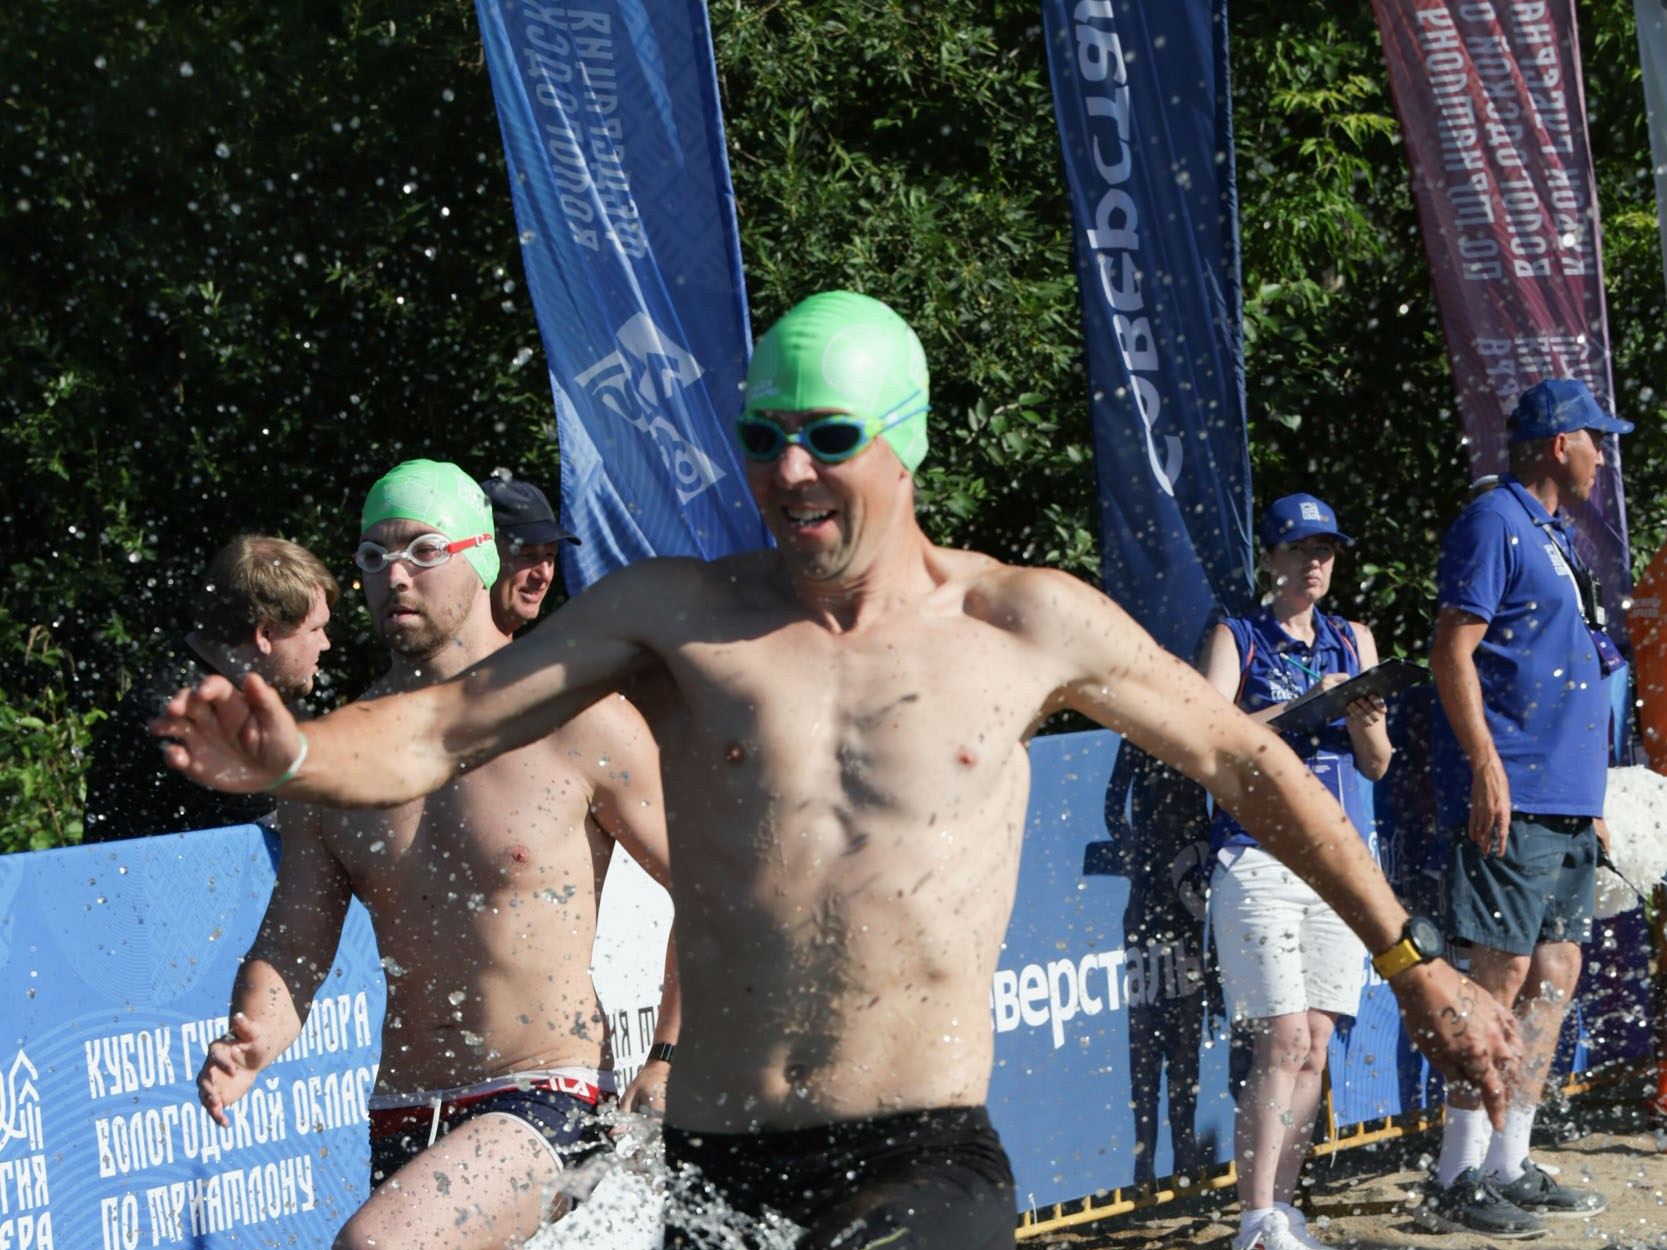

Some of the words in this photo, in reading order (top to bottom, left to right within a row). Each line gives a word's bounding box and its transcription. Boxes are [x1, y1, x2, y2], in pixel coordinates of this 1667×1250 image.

[989, 938, 1203, 1050] версталь
[85, 1026, 175, 1099] КУБОК
[147, 1154, 316, 1247] ТРИАТЛОНУ
